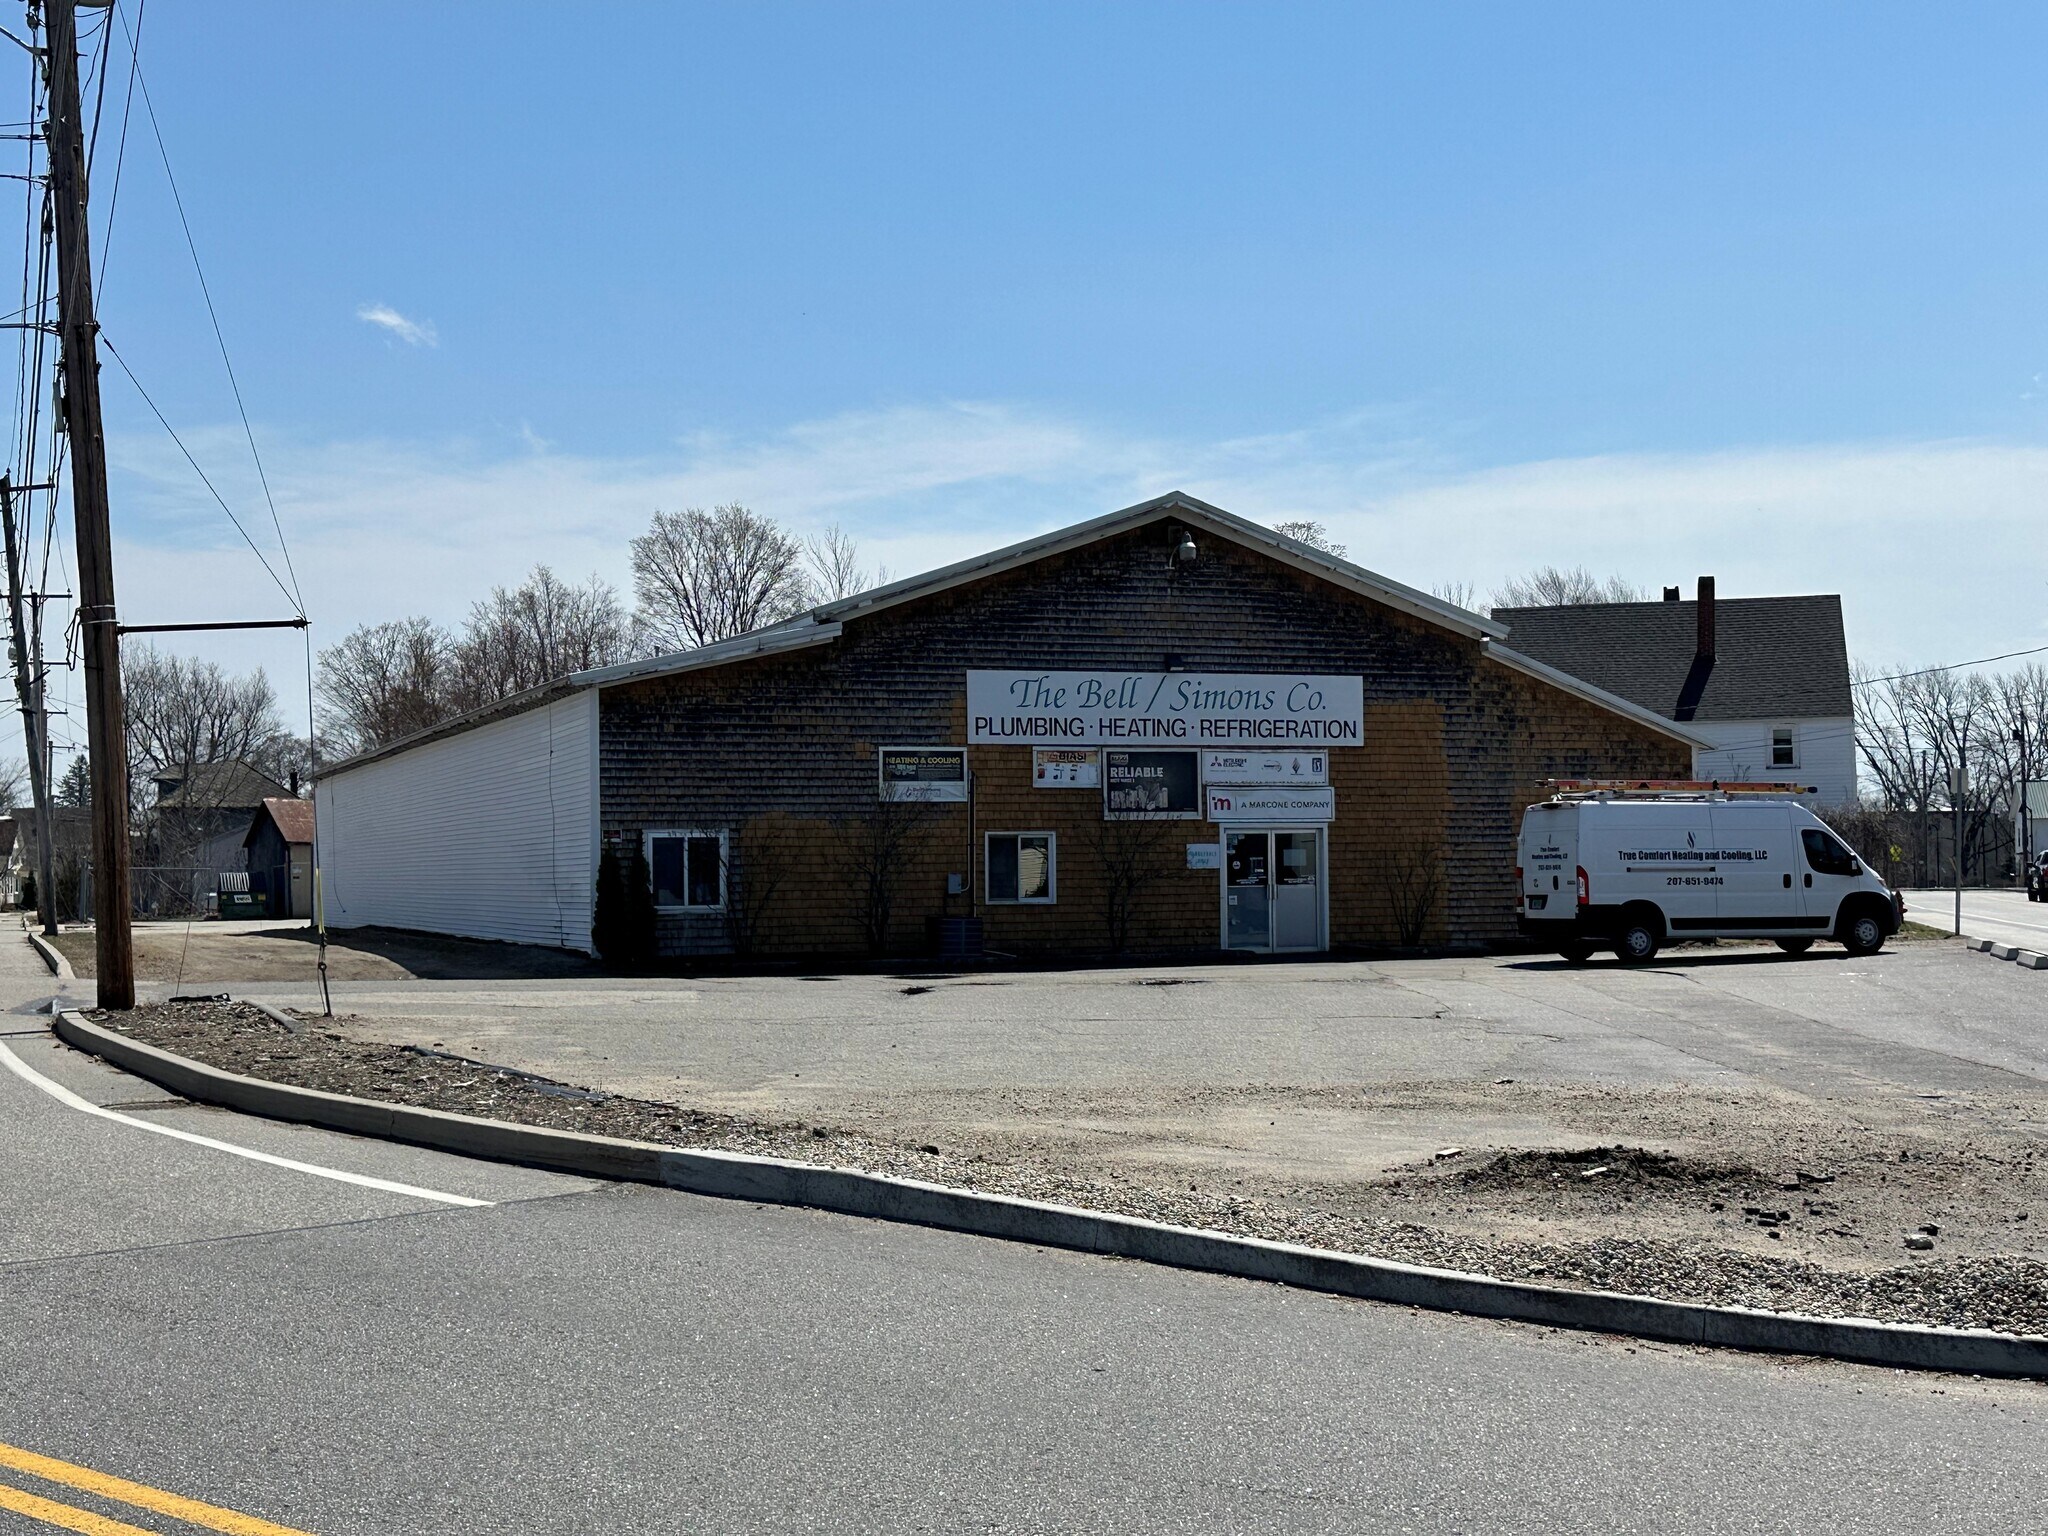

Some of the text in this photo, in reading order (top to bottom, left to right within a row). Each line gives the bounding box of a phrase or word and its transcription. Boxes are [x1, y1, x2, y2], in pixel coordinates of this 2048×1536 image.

[1010, 675, 1067, 709] The
[1076, 676, 1143, 709] Bell
[1169, 680, 1275, 712] Simons
[1286, 682, 1326, 712] Co.
[975, 716, 1357, 739] PLUMBING HEATING REFRIGERATION
[1110, 767, 1164, 778] RELIABLE
[1618, 851, 1637, 861] True
[1638, 851, 1671, 861] Comfort
[1672, 851, 1704, 862] Heating
[1704, 851, 1720, 861] and
[1754, 851, 1768, 860] LLC
